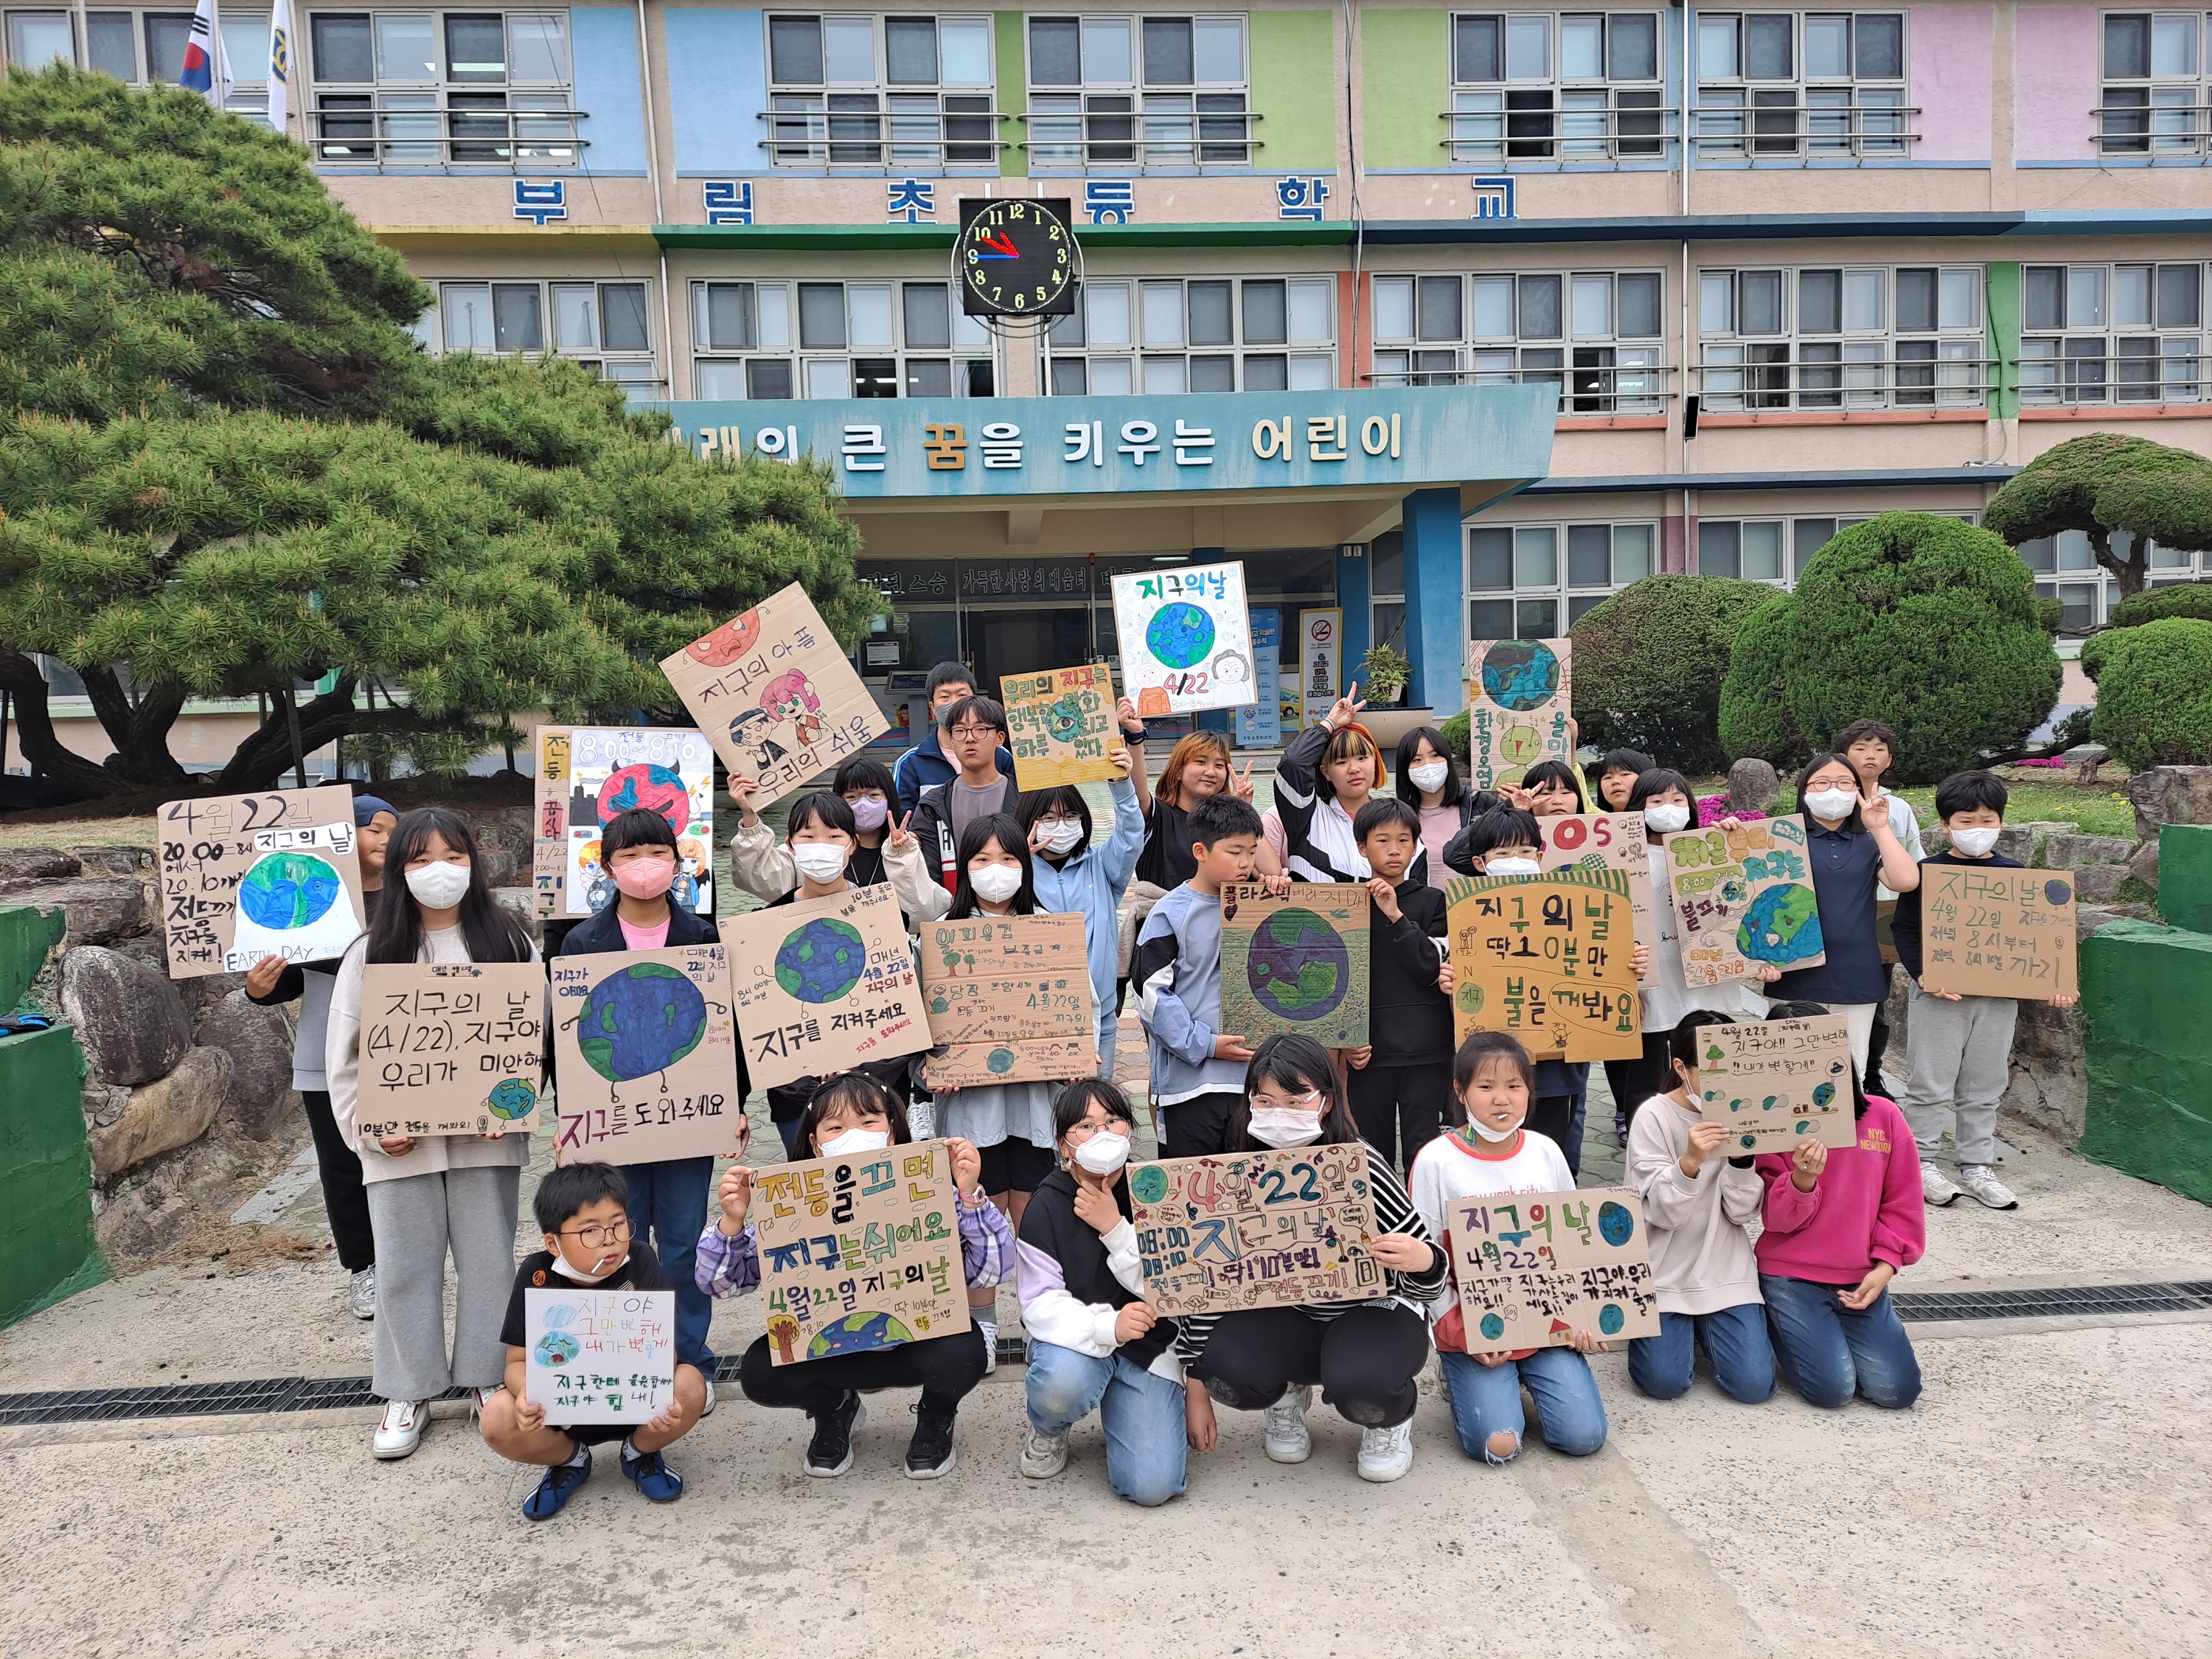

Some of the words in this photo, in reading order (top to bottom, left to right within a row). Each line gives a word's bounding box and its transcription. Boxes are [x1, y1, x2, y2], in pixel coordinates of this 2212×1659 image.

[990, 210, 1004, 225] 11
[1009, 204, 1024, 219] 12
[1035, 210, 1041, 225] 1
[974, 226, 991, 241] 10
[1049, 225, 1060, 240] 2
[967, 248, 978, 264] 9
[1057, 248, 1067, 264] 3
[975, 269, 986, 285] 8
[1051, 268, 1062, 285] 4
[992, 287, 1002, 302] 7
[1015, 293, 1025, 309] 6
[1036, 286, 1046, 301] 5
[841, 425, 886, 471] 큰
[923, 422, 1023, 470] 꿈을
[1065, 419, 1215, 467] 키우는
[1253, 414, 1402, 462] 어린이
[908, 571, 947, 594] 스승
[963, 568, 1002, 594] 가득한
[1005, 567, 1044, 593] 사랑의
[698, 653, 771, 703] 지구의
[772, 626, 816, 658] 아픔
[1004, 675, 1054, 704] 우리의
[1060, 666, 1107, 689] 지구는
[1164, 672, 1209, 695] 4/22
[1005, 701, 1051, 732] 행복한
[1078, 714, 1109, 737] 되고
[619, 732, 644, 742] 전등
[1012, 733, 1049, 758] 하루
[757, 747, 822, 796] 우리의
[167, 801, 233, 842] 4월
[240, 795, 315, 832] 22일
[257, 830, 316, 848] 지구의
[329, 824, 352, 853] 날
[535, 845, 568, 860] 4/22
[166, 859, 203, 873] 에서
[1742, 849, 1806, 882] 지구는
[851, 888, 872, 903] 10분
[878, 883, 891, 894] 동안
[1293, 886, 1340, 903] 버리지
[1939, 870, 2014, 902] 지구의
[2020, 880, 2039, 907] 날
[1475, 894, 1573, 933] 지구의
[1585, 894, 1613, 941] 날
[1930, 897, 1957, 922] 4월
[1965, 905, 2001, 929] 22일
[1930, 925, 1956, 941] 저녁
[281, 945, 313, 961] DAY
[870, 947, 903, 964] 매년
[1486, 936, 1511, 960] 딱
[1690, 948, 1723, 961] 매년
[554, 967, 588, 981] 지구가
[863, 967, 883, 981] 4월
[887, 958, 909, 974] 22일
[1464, 966, 1473, 977] N
[1696, 964, 1718, 984] 4월
[1718, 960, 1745, 975] 22일
[865, 976, 898, 993] 지구의
[903, 972, 914, 986] 날
[737, 987, 752, 1000] 8시
[1461, 988, 1480, 1004] 지구
[385, 989, 481, 1018] 지구의
[507, 990, 531, 1020] 날
[956, 1006, 973, 1017] 전등
[1503, 976, 1547, 1028] 불을
[1552, 991, 1633, 1032] 꺼봐요
[1052, 1014, 1086, 1023] 지구의
[1470, 1016, 1476, 1027] S
[464, 1020, 541, 1045] 지구야
[752, 1018, 821, 1062] 지구를
[830, 1002, 906, 1031] 지켜주세요
[855, 1036, 877, 1054] 지구를
[880, 1018, 912, 1038] 도와주세요
[1722, 1026, 1742, 1039] 4월
[1745, 1026, 1769, 1036] 22일
[378, 1060, 458, 1092] 우리가
[479, 1051, 543, 1074] 미안해
[1744, 1061, 1764, 1071] 내가
[358, 1121, 398, 1136] 10분만
[560, 1105, 629, 1148] 지구를
[1868, 1128, 1885, 1141] NYC
[757, 1164, 856, 1225] 전등을
[1188, 1169, 1253, 1212] 4월
[1258, 1161, 1346, 1205] 22일
[1459, 1205, 1551, 1248] 지구의
[1562, 1200, 1592, 1246] 날
[764, 1234, 866, 1273] 지구는
[863, 1212, 951, 1265] 쉬어요
[1137, 1227, 1190, 1254] 08:00
[1192, 1214, 1298, 1261] 지구의
[1304, 1208, 1329, 1238] 날
[1141, 1251, 1187, 1278] 08:10
[1467, 1241, 1503, 1273] 4월
[1503, 1245, 1557, 1270] 22일
[769, 1286, 811, 1323] 4월
[813, 1277, 858, 1312] 22일
[862, 1263, 924, 1293] 지구의
[927, 1256, 950, 1295] 날
[1270, 1277, 1304, 1301] 전등
[1303, 1267, 1349, 1288] 끄기!
[577, 1296, 653, 1317] 지구야
[894, 1301, 908, 1316] 딱
[911, 1298, 939, 1312] 10분만
[914, 1316, 930, 1330] 전등
[585, 1339, 625, 1353] 내가
[553, 1374, 620, 1390] 지구한테
[553, 1394, 598, 1408] 지구야
[605, 1393, 625, 1412] 힘
